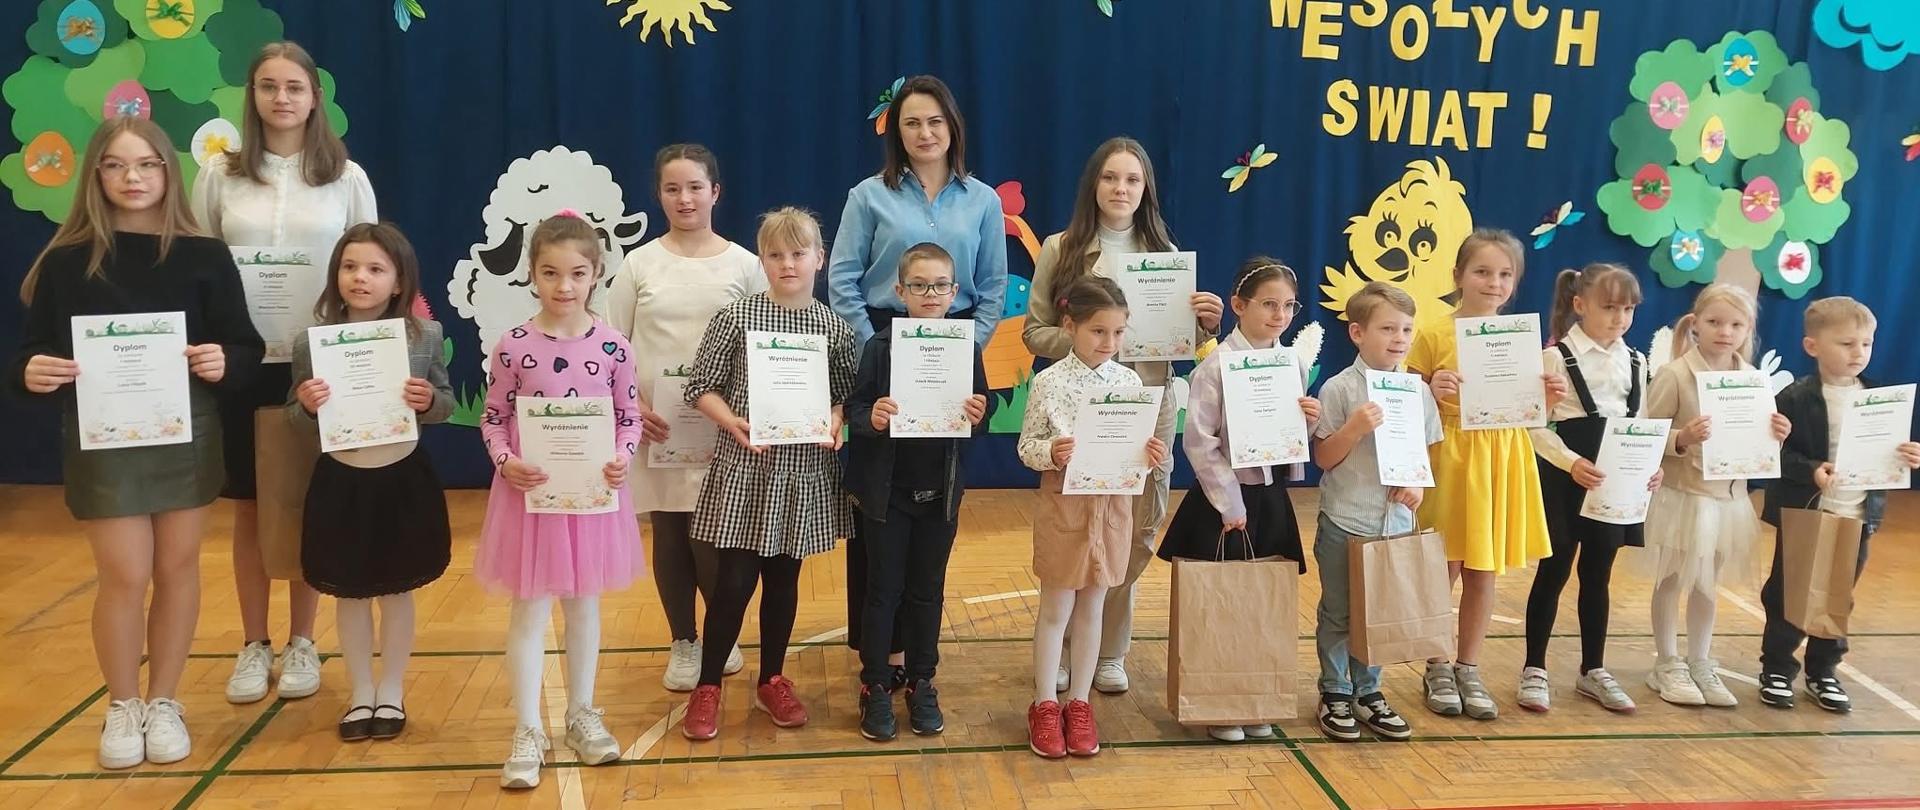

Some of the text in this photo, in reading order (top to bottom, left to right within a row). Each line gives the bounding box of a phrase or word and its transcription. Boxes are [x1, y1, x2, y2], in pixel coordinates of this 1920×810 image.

[1527, 93, 1553, 150] !
[258, 271, 288, 279] Dyplom
[113, 343, 148, 353] Dyplom
[919, 345, 945, 353] Dyplom
[1485, 340, 1512, 349] Dyplom
[344, 348, 374, 358] Dyplom
[768, 354, 808, 363] Wyróżnienie
[1248, 374, 1273, 384] Dyplom
[1097, 408, 1138, 417] Wyróżnienie
[541, 422, 589, 431] Wyróżnienie
